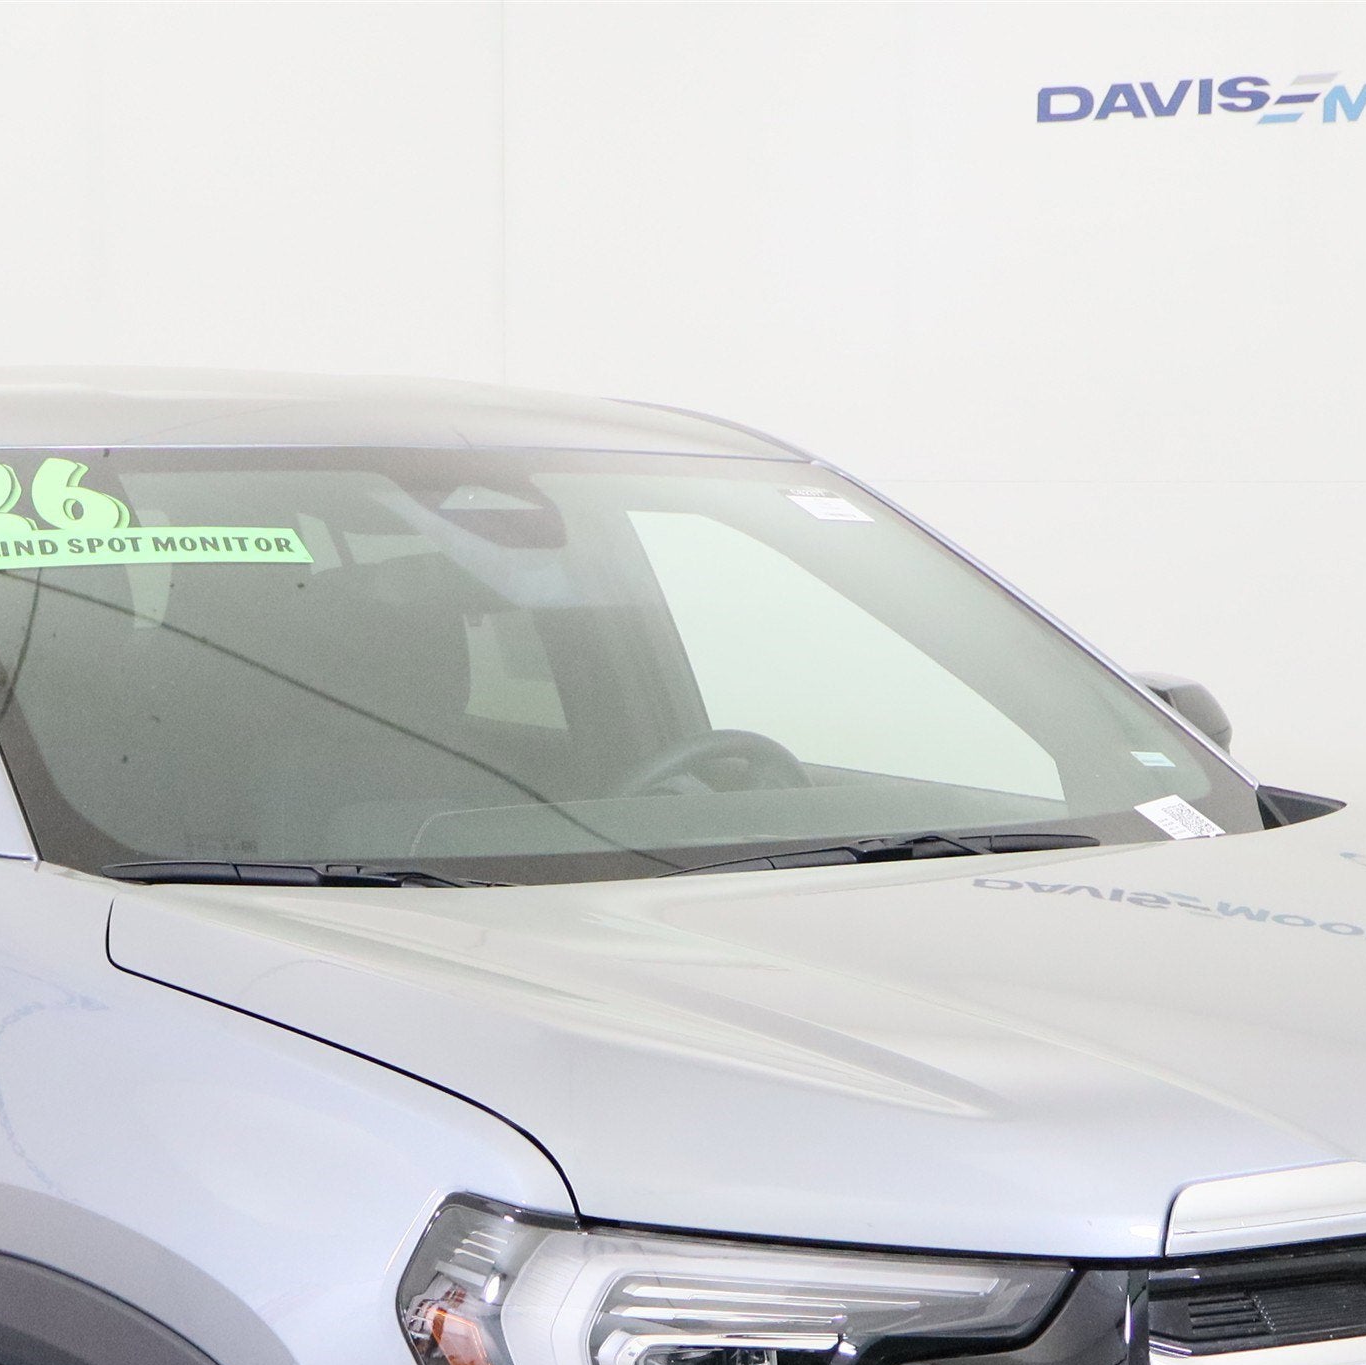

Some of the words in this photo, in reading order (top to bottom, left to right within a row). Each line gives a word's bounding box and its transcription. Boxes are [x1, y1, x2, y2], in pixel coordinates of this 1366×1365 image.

[1037, 76, 1269, 122] DAVIS
[67, 536, 142, 554] SPOT
[152, 536, 295, 553] MONITOR
